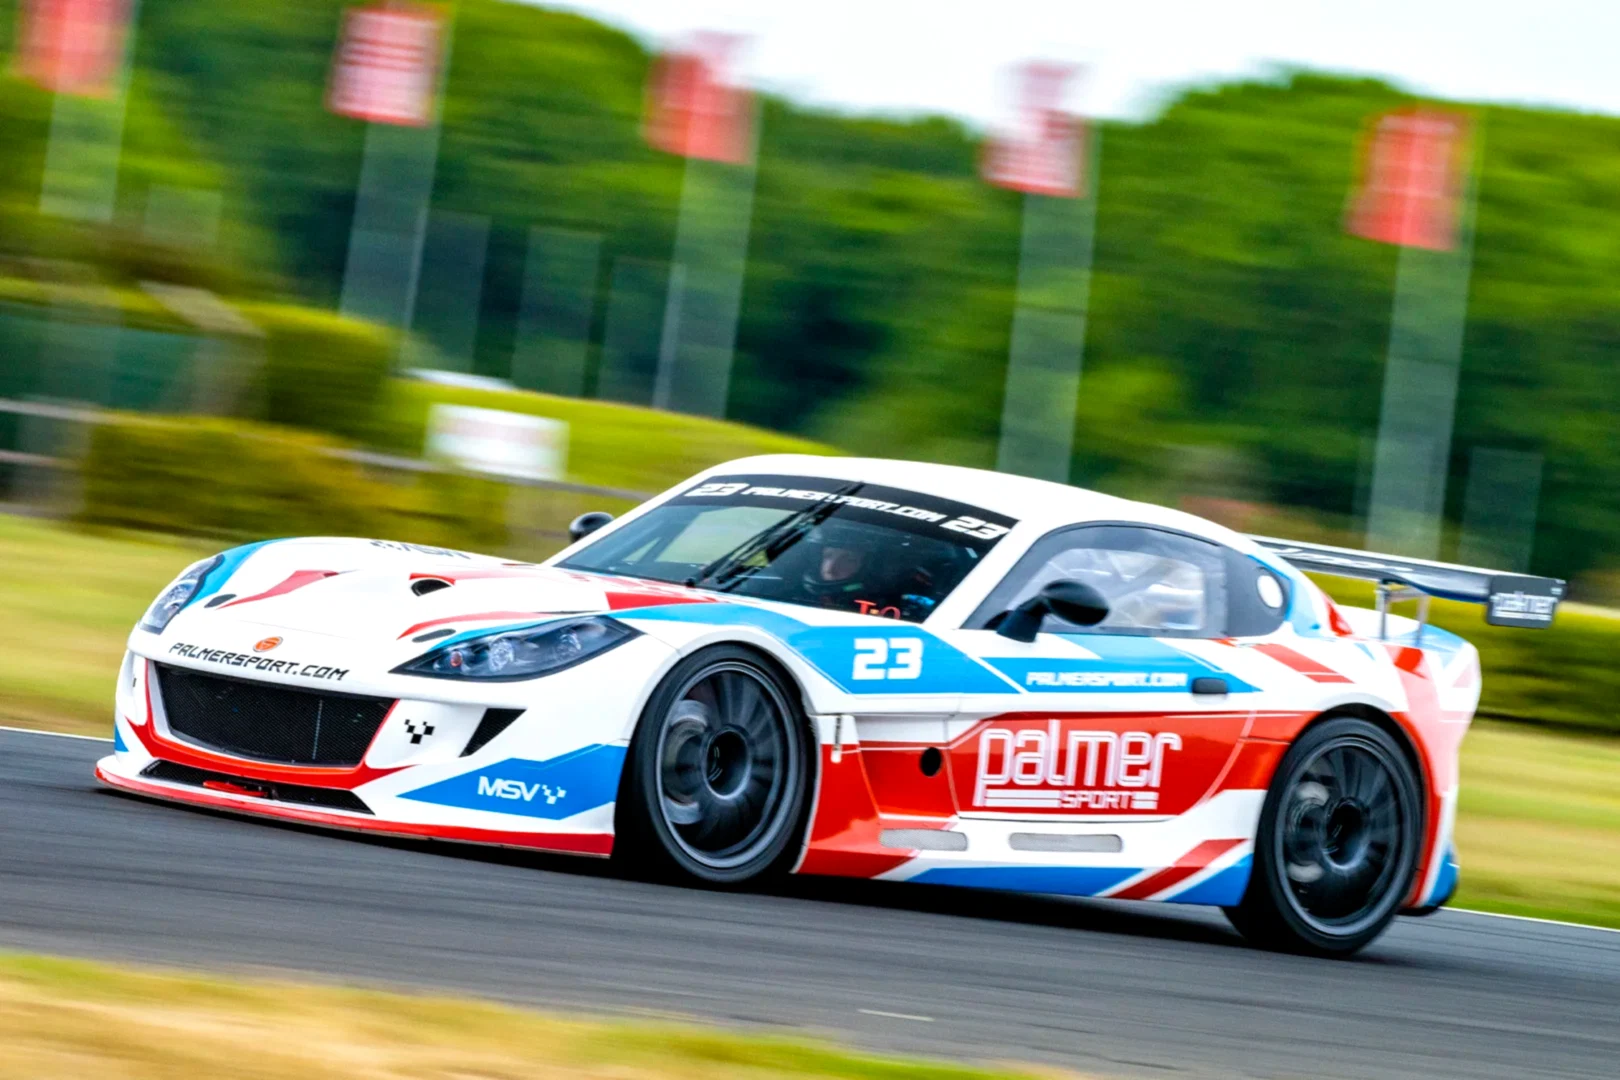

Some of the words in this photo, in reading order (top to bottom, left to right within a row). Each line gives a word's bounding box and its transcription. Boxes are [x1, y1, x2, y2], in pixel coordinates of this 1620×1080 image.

[684, 482, 749, 497] 23
[940, 516, 1010, 540] 23
[169, 641, 350, 681] PALMERSPORT.COM
[852, 637, 923, 681] 23
[1026, 671, 1187, 688] PALMERSPORT.COM
[973, 719, 1182, 806] palmer
[477, 776, 541, 801] MSV
[1060, 790, 1133, 809] SPORT
